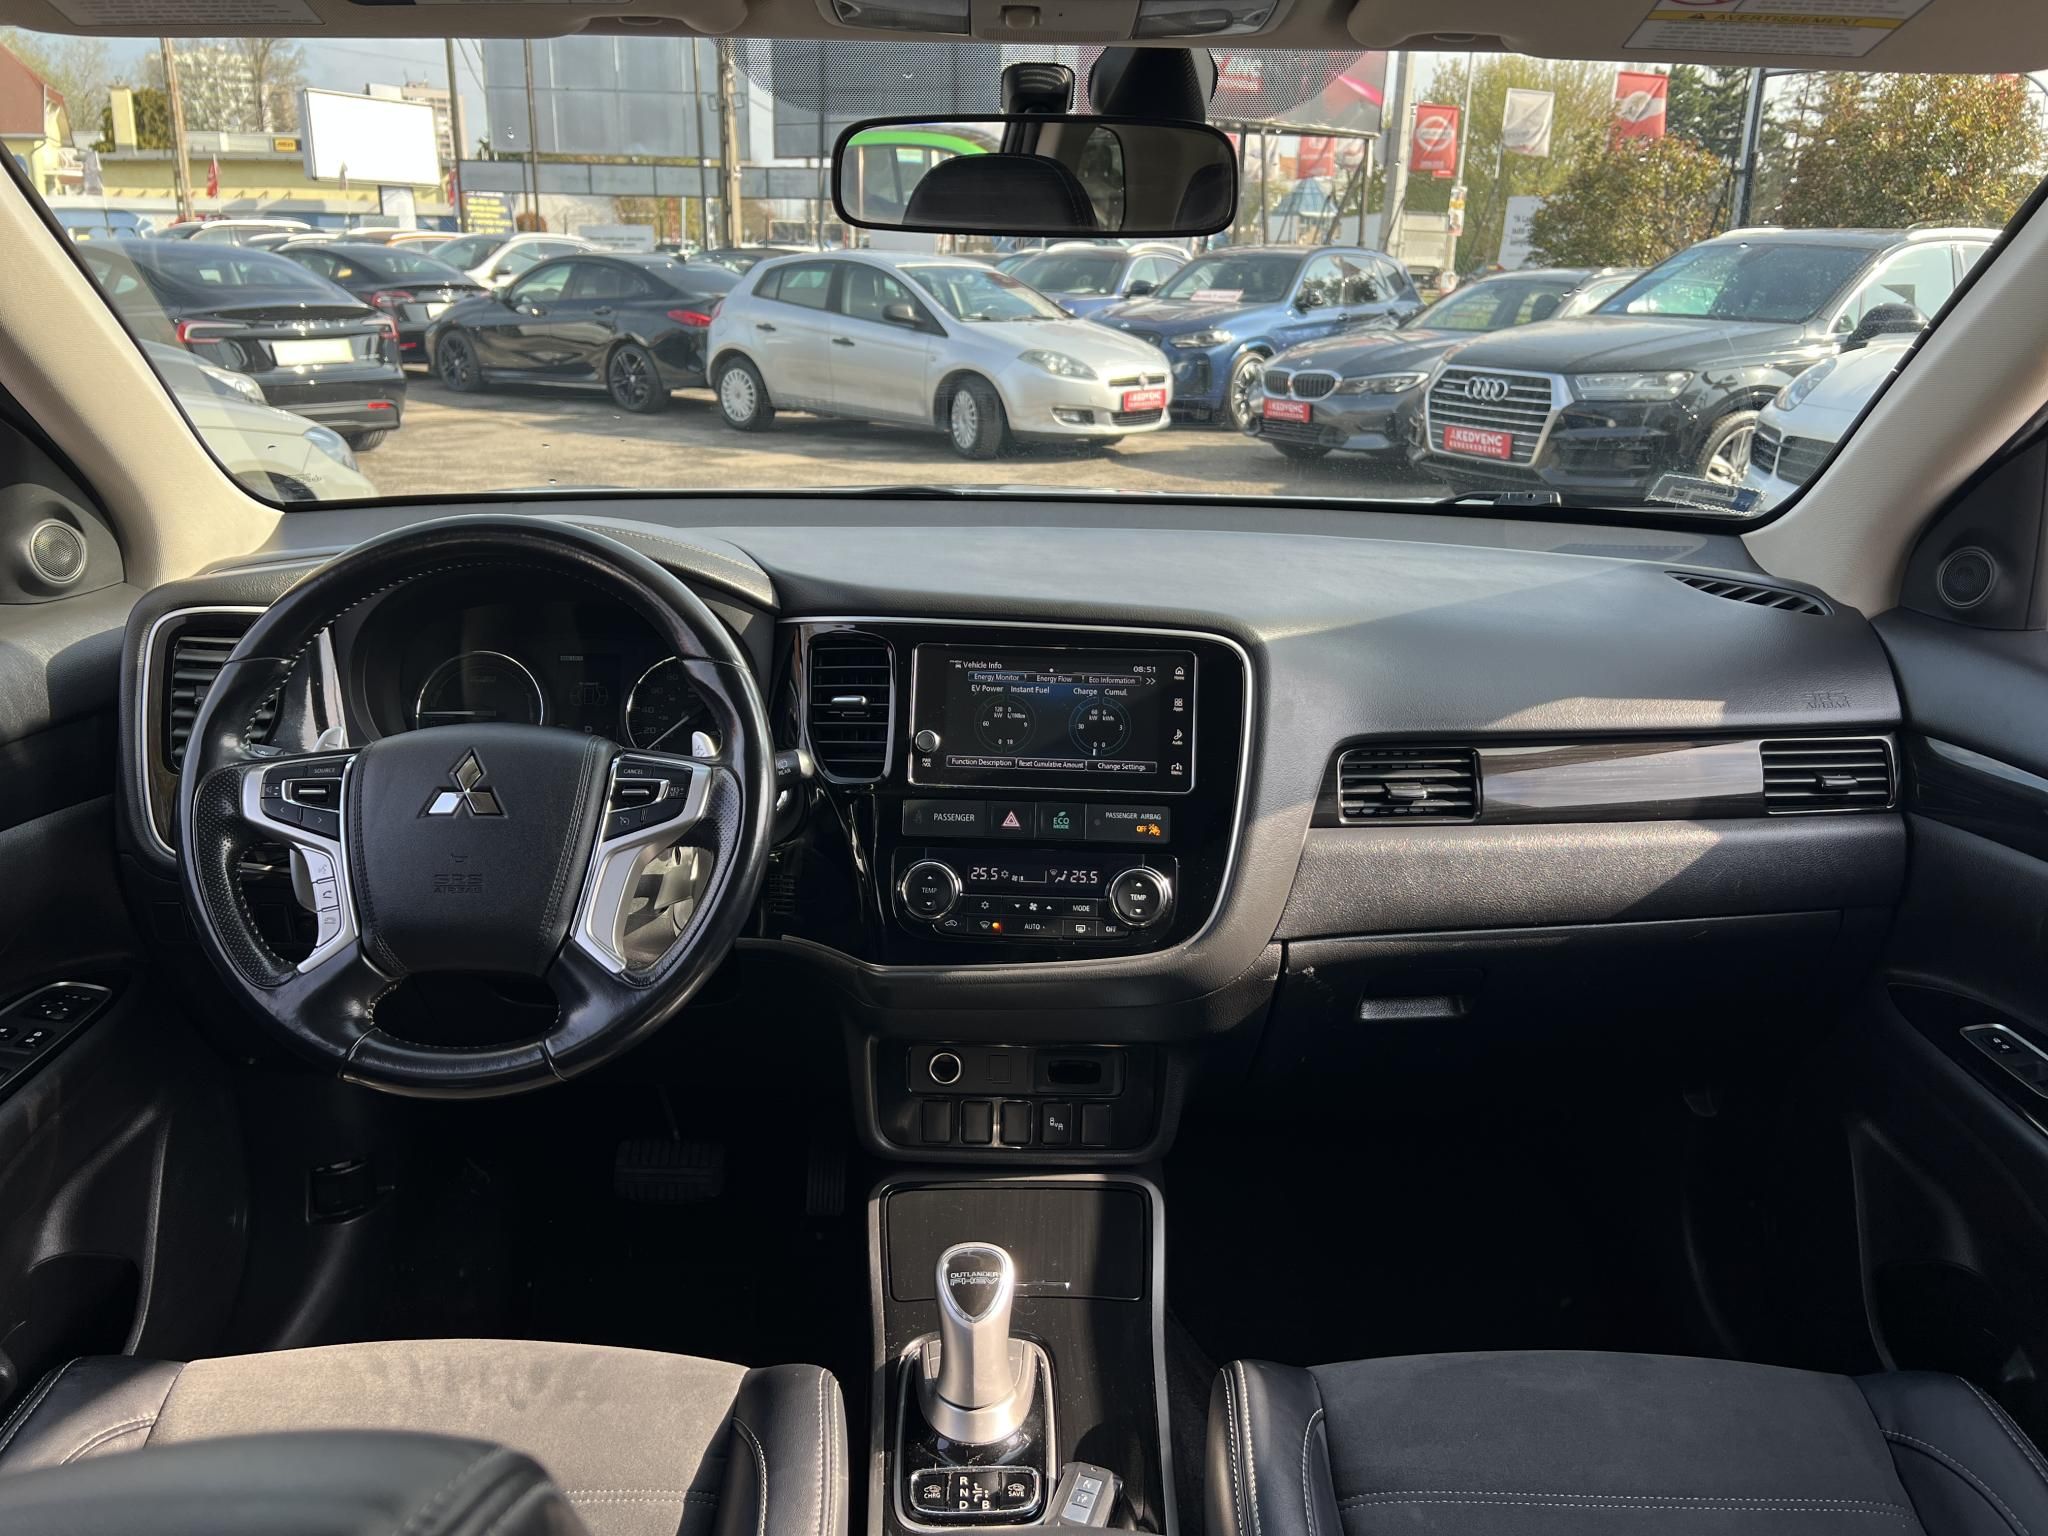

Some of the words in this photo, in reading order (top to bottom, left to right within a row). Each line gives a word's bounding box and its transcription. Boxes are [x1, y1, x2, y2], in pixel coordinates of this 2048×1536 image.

[963, 661, 987, 669] Vehicle
[1133, 665, 1156, 673] 08:51
[974, 673, 995, 682] Energy
[995, 673, 1020, 681] Monitor
[1036, 674, 1056, 684] Energy
[1056, 675, 1073, 683] Flow
[971, 684, 981, 692] EV
[1010, 685, 1034, 693] Instant
[1073, 687, 1098, 697] Charge
[951, 757, 978, 765] Function
[978, 758, 1012, 767] Description
[1033, 760, 1062, 768] Cumulative
[1097, 763, 1121, 771] Change
[1121, 763, 1146, 772] Settings
[933, 812, 975, 822] PASSENGER
[1105, 811, 1138, 819] PASSENGER
[1140, 812, 1162, 820] AIRBAG
[1053, 817, 1070, 825] ECO
[970, 867, 998, 880] 25.5
[1069, 870, 1098, 883] 25.5
[1130, 893, 1147, 901] TEMP
[1072, 904, 1090, 912] MODE
[959, 1476, 968, 1485] R
[959, 1488, 969, 1497] N
[959, 1500, 968, 1509] D
[981, 1500, 990, 1509] B
